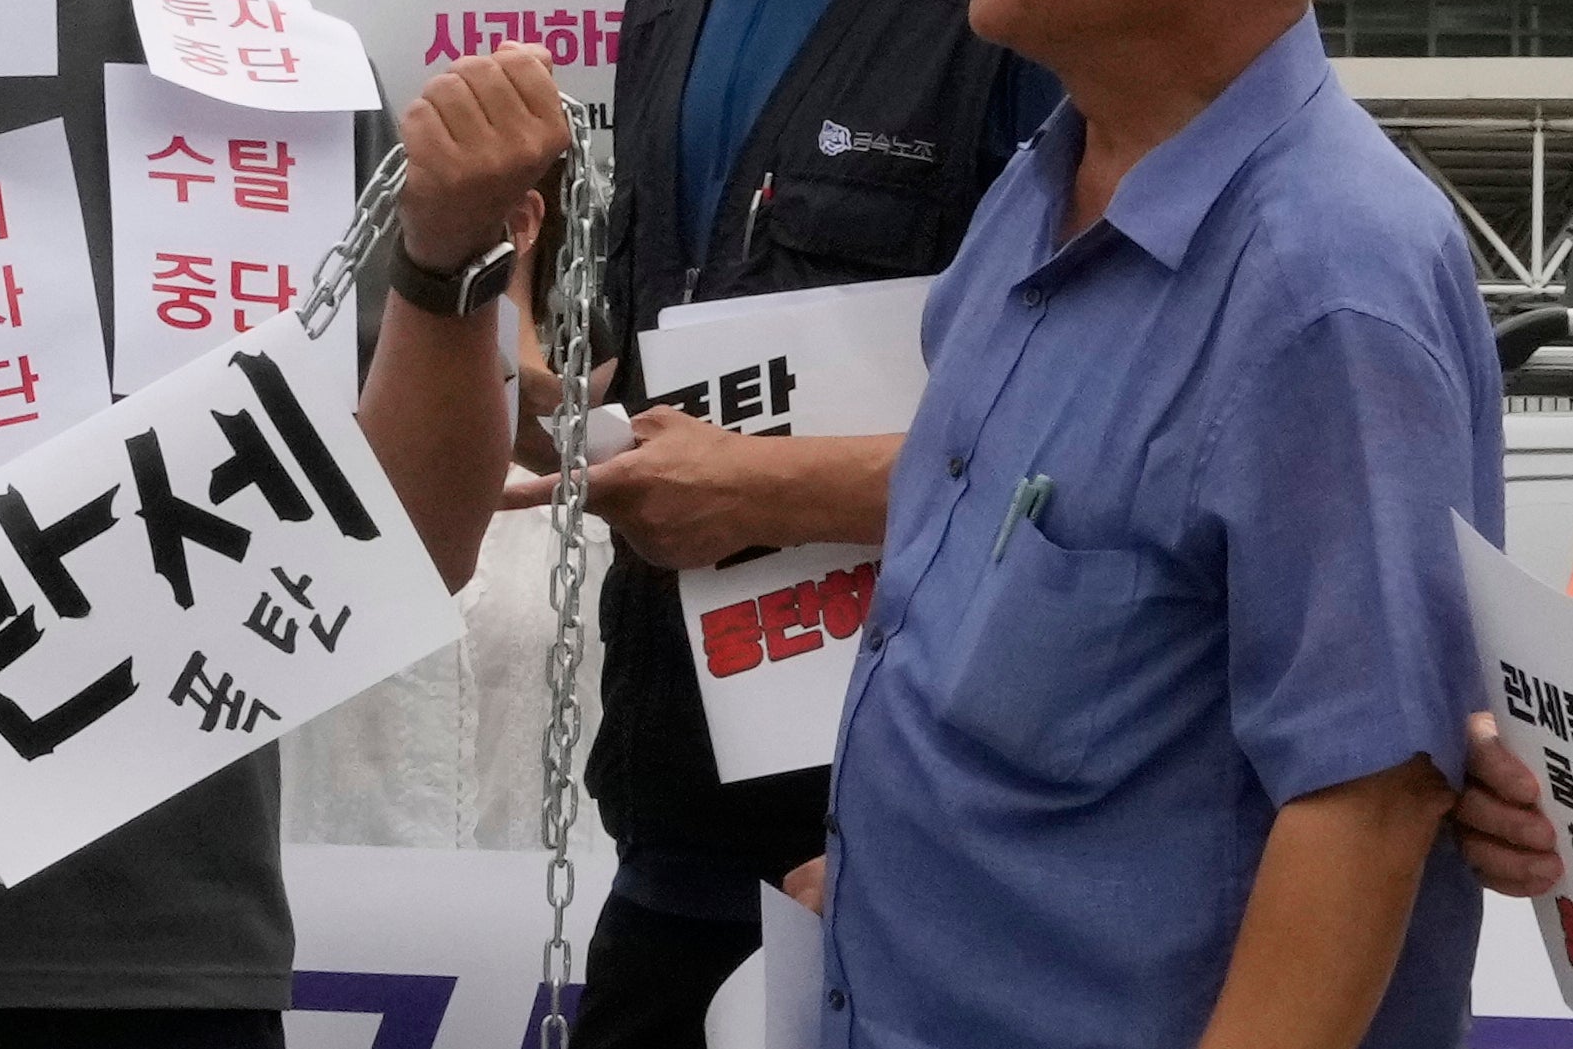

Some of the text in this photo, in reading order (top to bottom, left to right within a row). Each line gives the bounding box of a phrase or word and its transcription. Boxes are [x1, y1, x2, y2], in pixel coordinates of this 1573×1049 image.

[173, 34, 301, 84] 중단
[146, 134, 296, 214] 수탈
[152, 252, 298, 333] 중단
[168, 566, 352, 733] 폭탄
[1500, 659, 1573, 742] 관세
